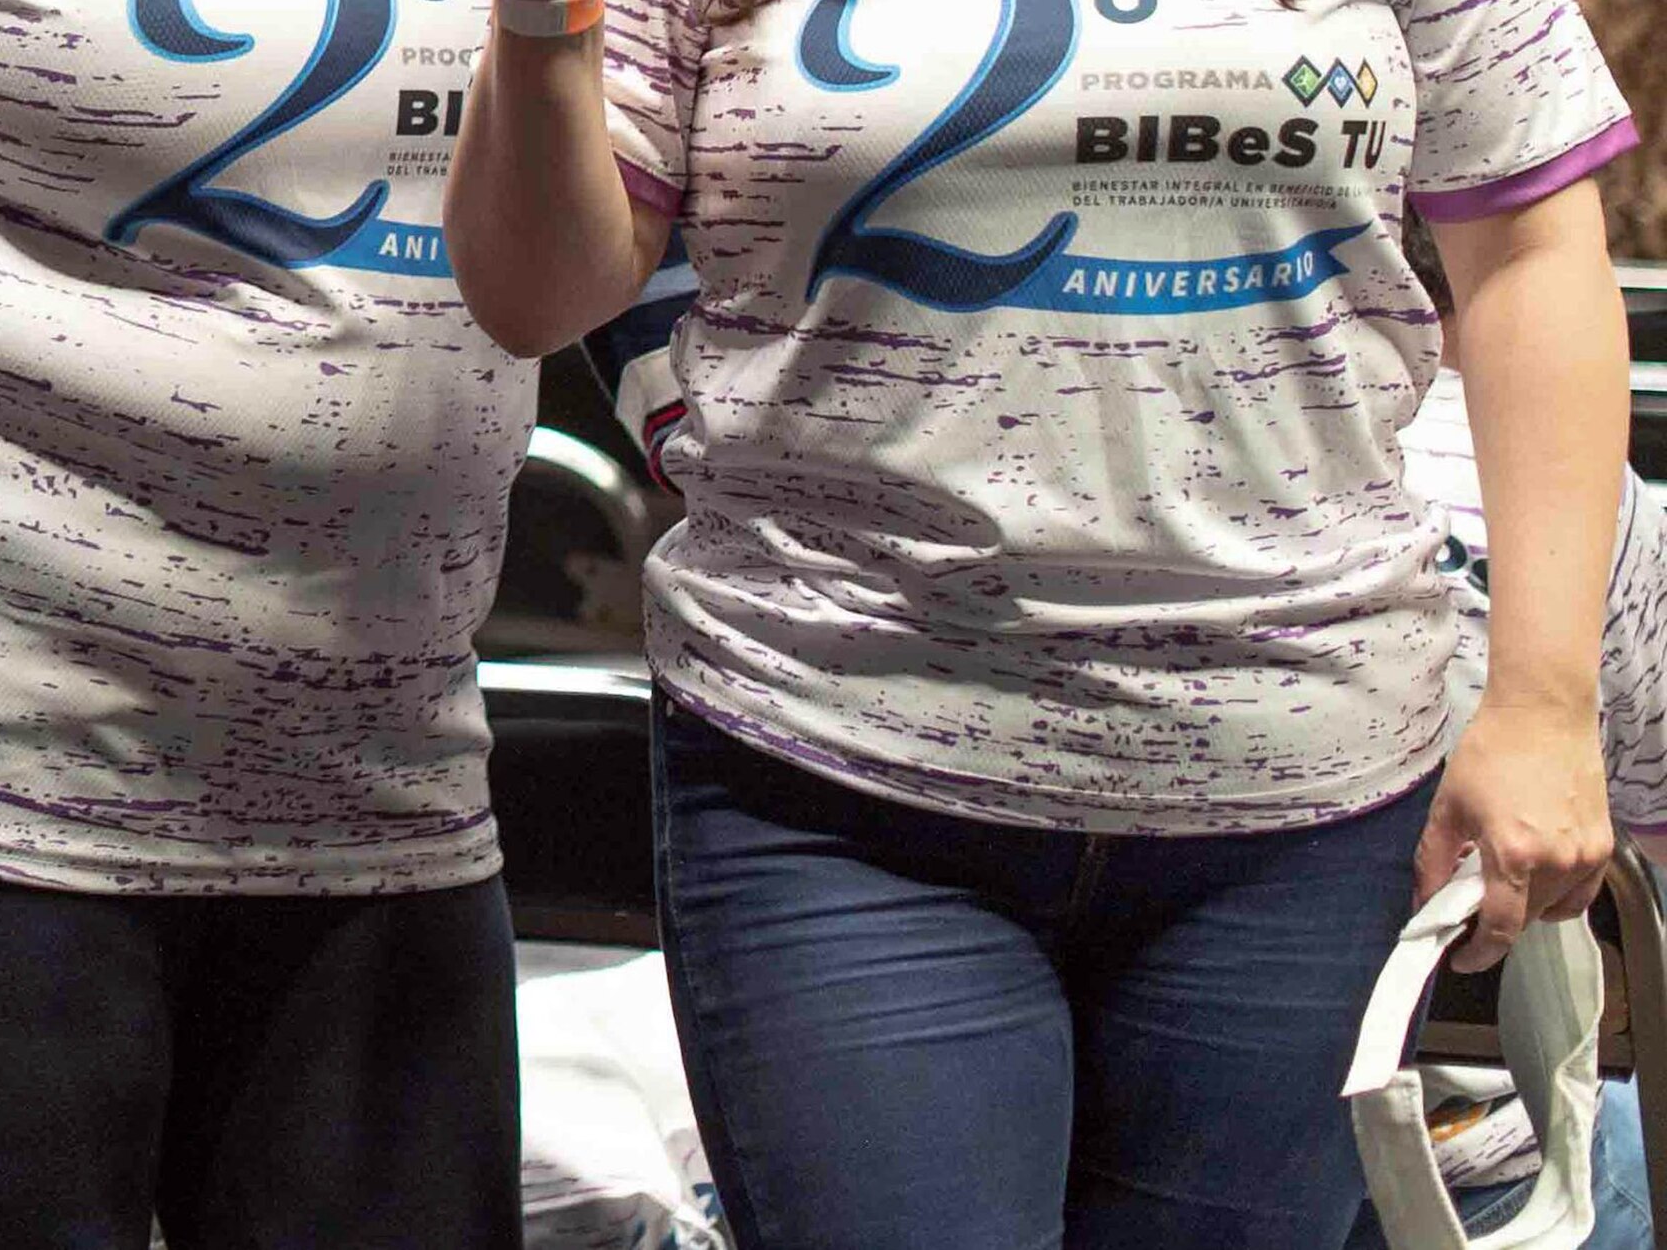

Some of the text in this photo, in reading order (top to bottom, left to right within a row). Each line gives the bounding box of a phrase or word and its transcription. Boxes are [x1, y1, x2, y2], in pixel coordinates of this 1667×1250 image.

[1081, 69, 1274, 91] PROGRAMA
[1074, 114, 1387, 170] BIBeS TU
[1071, 179, 1159, 192] BIENESTAR
[1165, 179, 1239, 192] INTEGRAL
[1072, 194, 1101, 207] DEL
[1108, 194, 1224, 209] TRABAJADOR/A
[1061, 249, 1315, 298] ANIVERSARIO
